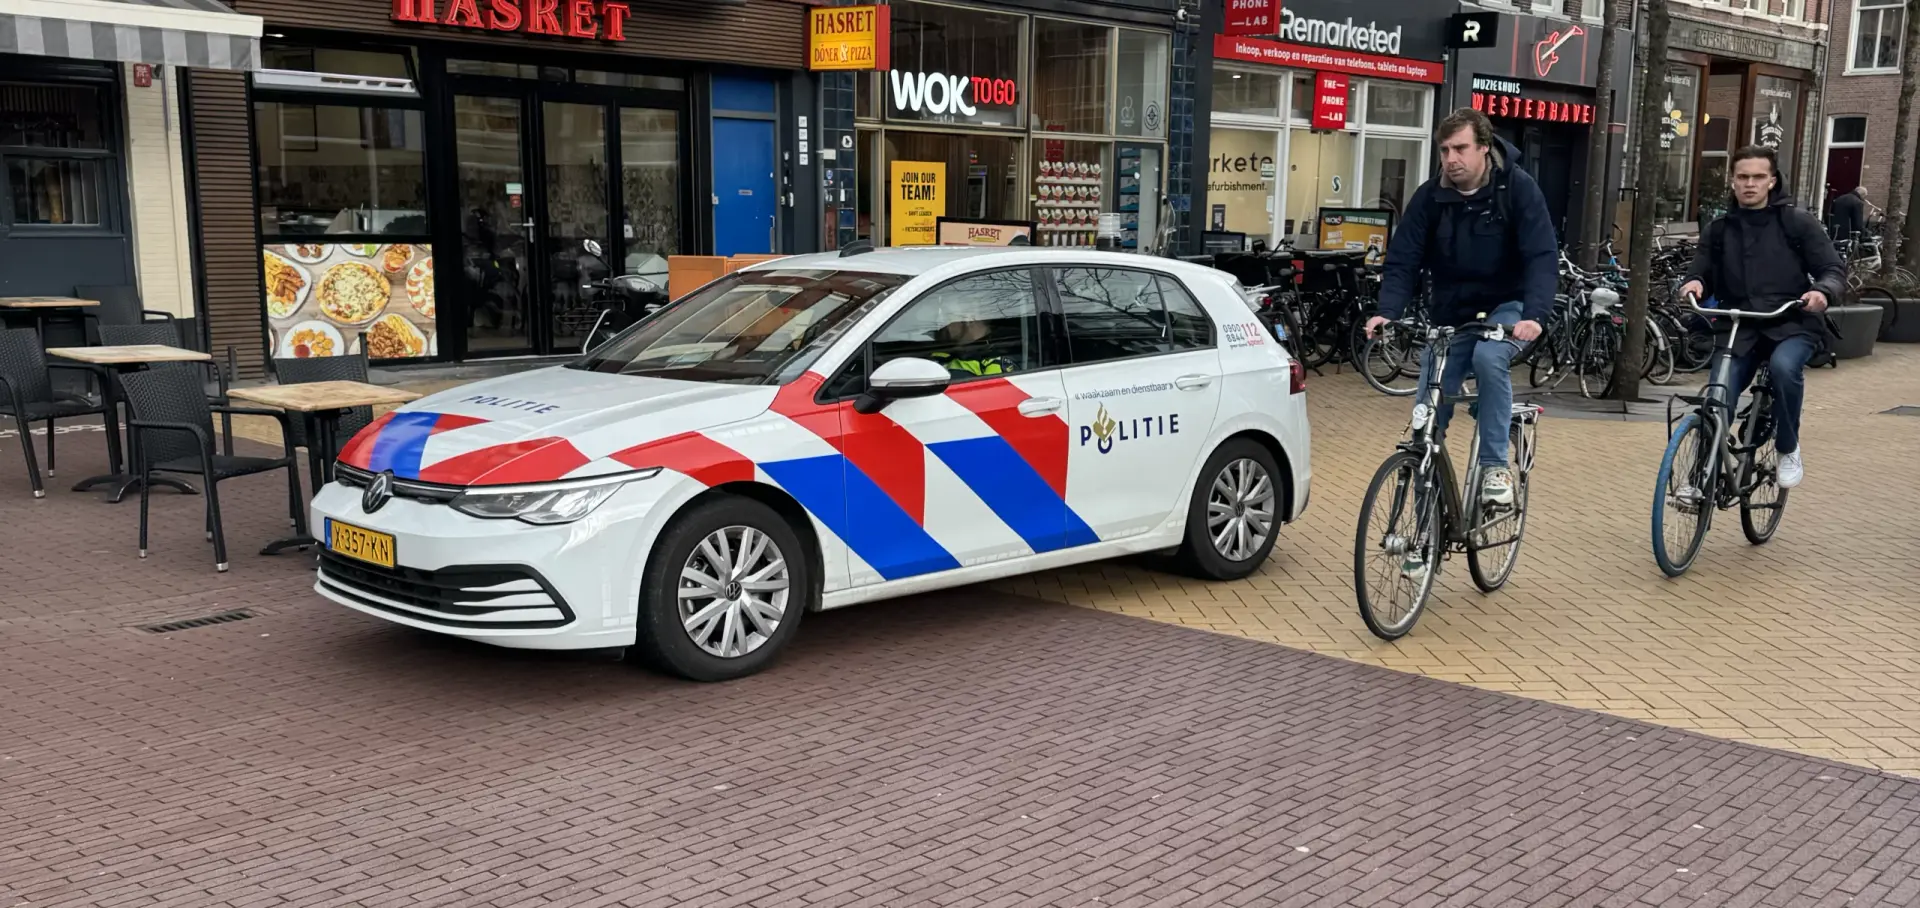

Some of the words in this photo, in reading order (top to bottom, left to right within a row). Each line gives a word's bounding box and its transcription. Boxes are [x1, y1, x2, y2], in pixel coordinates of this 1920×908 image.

[1232, 0, 1268, 9] PHONE
[815, 10, 874, 35] HASRET
[1278, 7, 1401, 55] Remarketed
[851, 46, 872, 61] PIZZA
[1235, 42, 1262, 57] Inkoop,
[1263, 47, 1290, 61] verkoop
[1291, 52, 1301, 60] en
[1301, 53, 1333, 64] reparaties
[1334, 57, 1346, 66] van
[1346, 57, 1376, 70] telefoons,
[1377, 61, 1398, 73] tablets
[1398, 65, 1406, 73] en
[1406, 64, 1428, 78] laptops
[891, 69, 977, 116] WOK
[971, 76, 992, 104] TO
[993, 78, 1016, 105] GO
[1472, 77, 1521, 94] MUZIEKHUIS
[1322, 95, 1344, 106] PHONE
[1471, 92, 1597, 125] WESTERHAVE
[901, 171, 919, 183] JOIN
[921, 172, 936, 184] OUR
[901, 184, 936, 201] TEAM!
[968, 227, 1002, 241] HASRET
[1222, 323, 1241, 333] 0900
[1241, 322, 1261, 337] 112
[1225, 332, 1246, 342] 8844
[1121, 387, 1131, 396] en
[459, 395, 561, 414] POLITIE
[1080, 413, 1179, 455] POLITIE
[335, 525, 389, 562] X-357-KN
